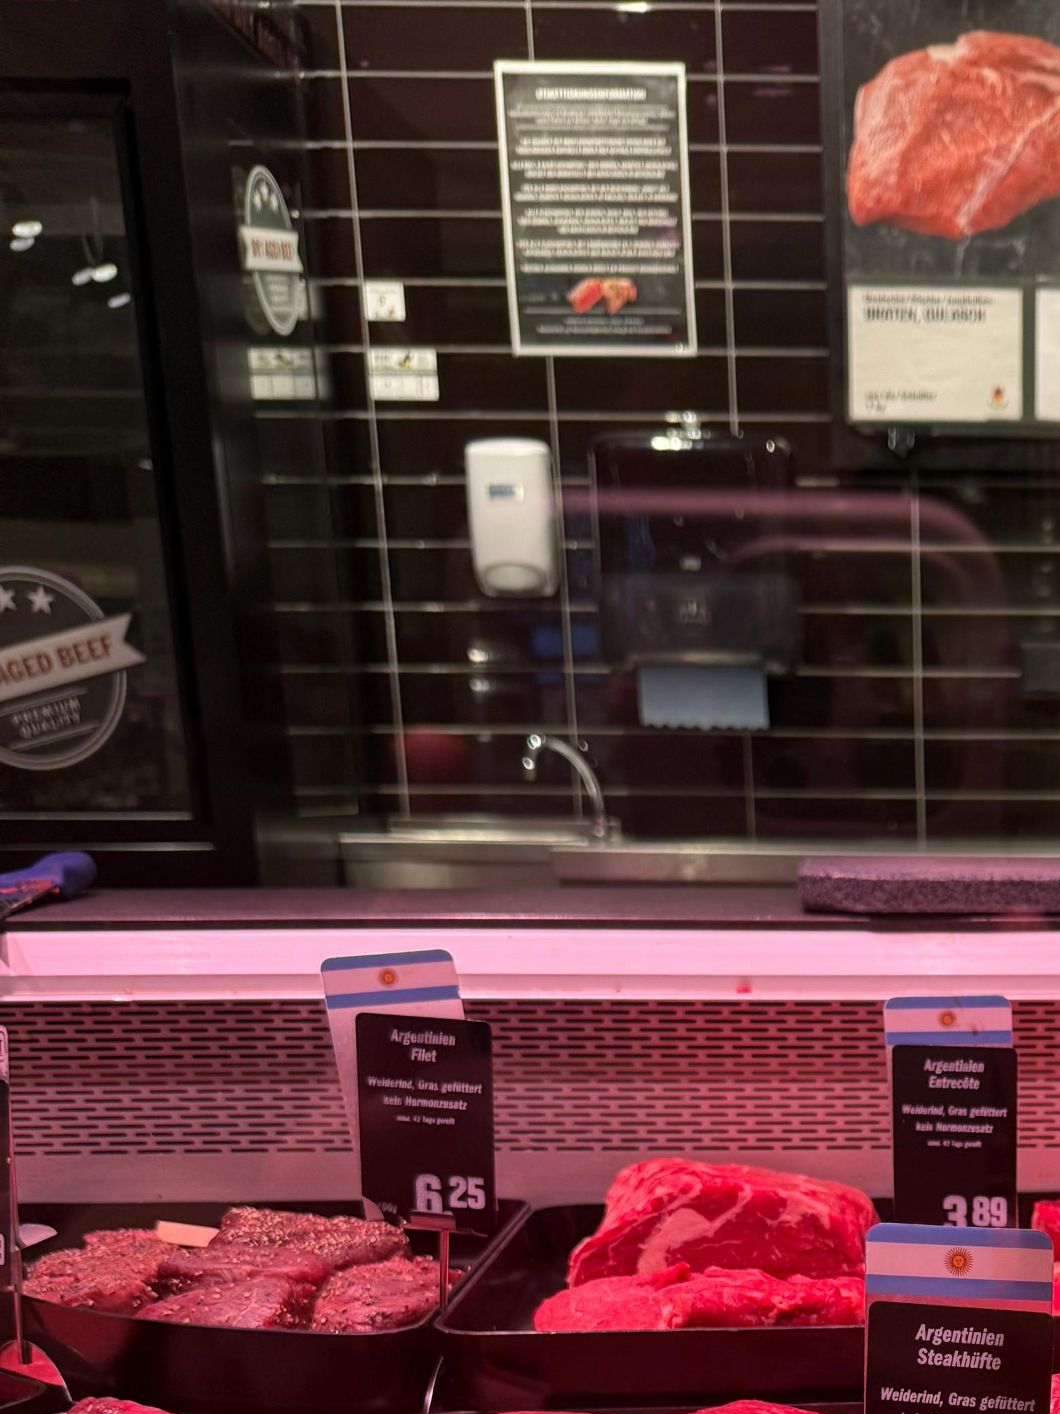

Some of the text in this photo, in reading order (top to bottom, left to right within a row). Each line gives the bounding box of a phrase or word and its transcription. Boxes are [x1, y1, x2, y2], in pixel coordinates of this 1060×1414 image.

[57, 635, 113, 670] BEEF
[390, 1028, 456, 1047] Argentinien
[410, 1047, 437, 1063] Filet
[923, 1058, 985, 1075] Argentinien
[418, 1080, 439, 1092] Gras
[441, 1081, 482, 1095] gefüttert
[404, 1095, 468, 1111] Hormonzusatz
[947, 1105, 968, 1117] Gras
[969, 1106, 1008, 1119] gefüttert
[915, 1121, 994, 1134] kein Hormonzusatz
[915, 1323, 1004, 1347] Argentinien
[917, 1347, 1002, 1371] Steakhüfte
[880, 1387, 1036, 1412] Weiderind, Gras gefüttert
